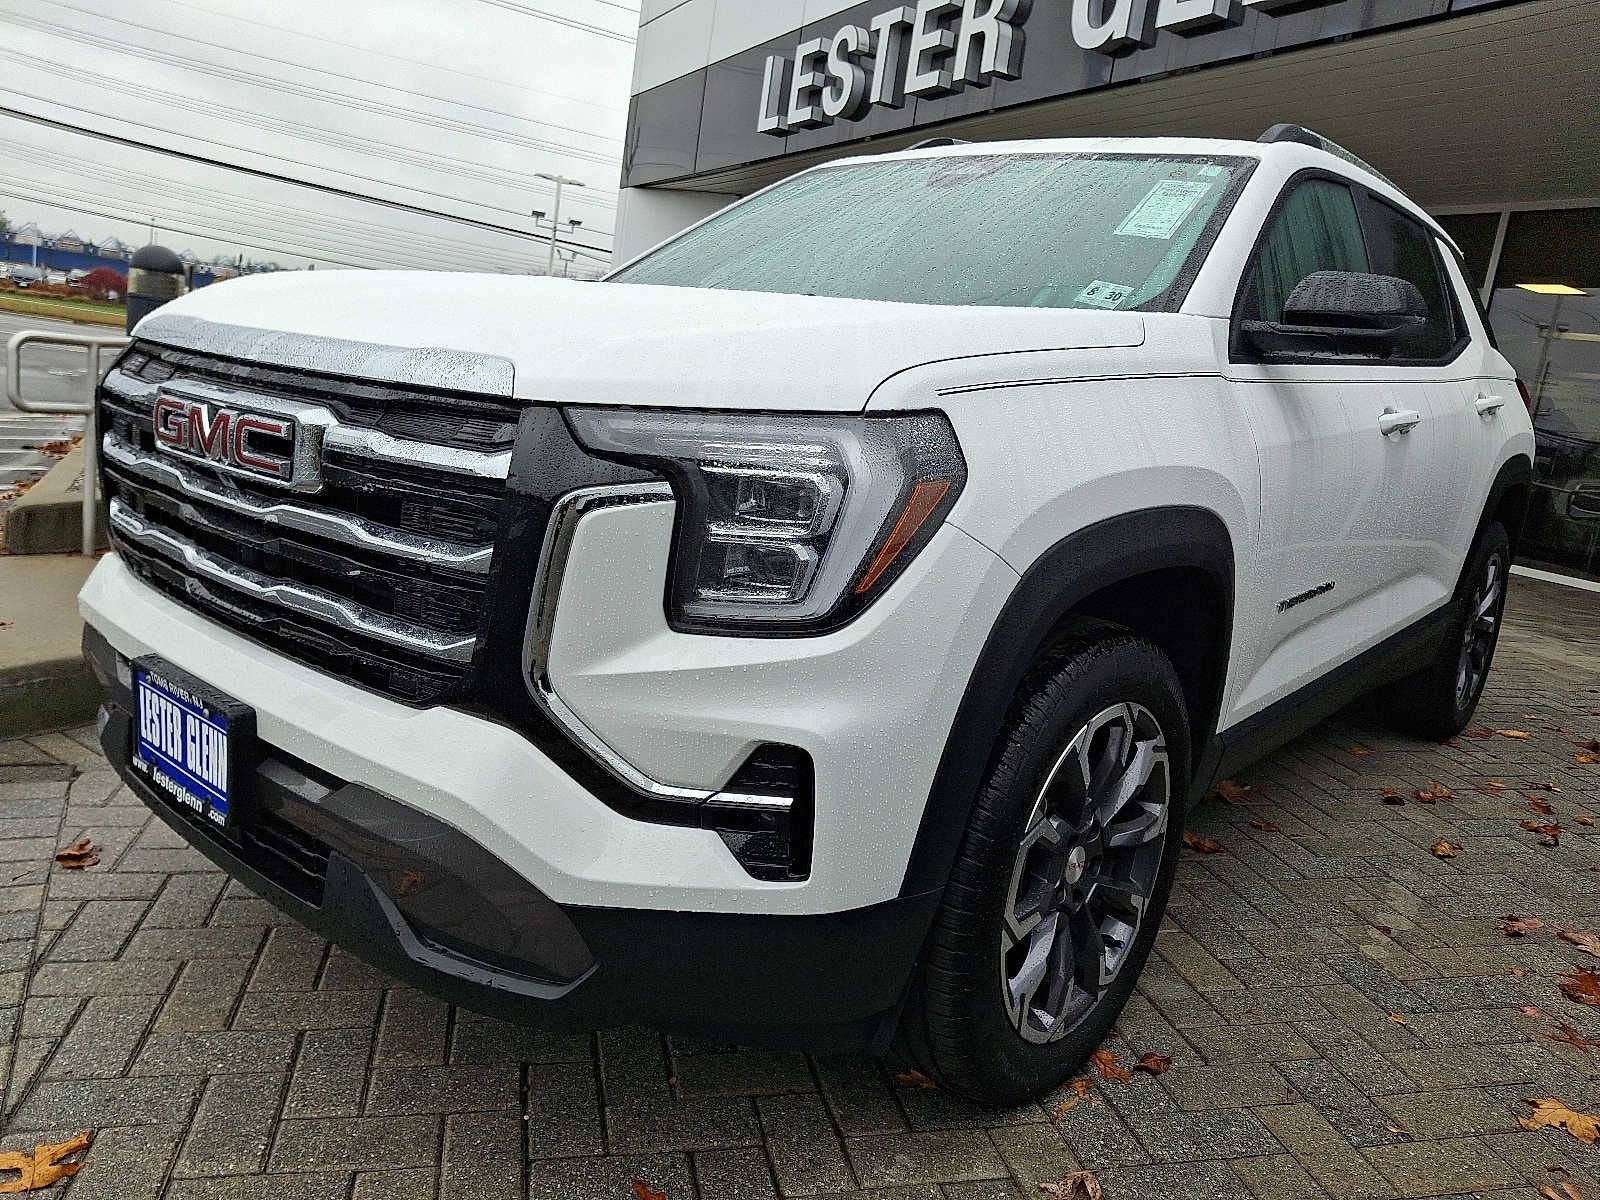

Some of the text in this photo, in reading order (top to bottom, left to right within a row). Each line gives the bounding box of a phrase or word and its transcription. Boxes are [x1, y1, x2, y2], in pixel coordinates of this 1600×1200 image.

[757, 0, 1024, 133] LESTER
[1105, 291, 1123, 301] 30
[153, 398, 286, 473] GMC
[139, 685, 228, 793] LESTER GLENN
[153, 766, 203, 813] lesterglenn
